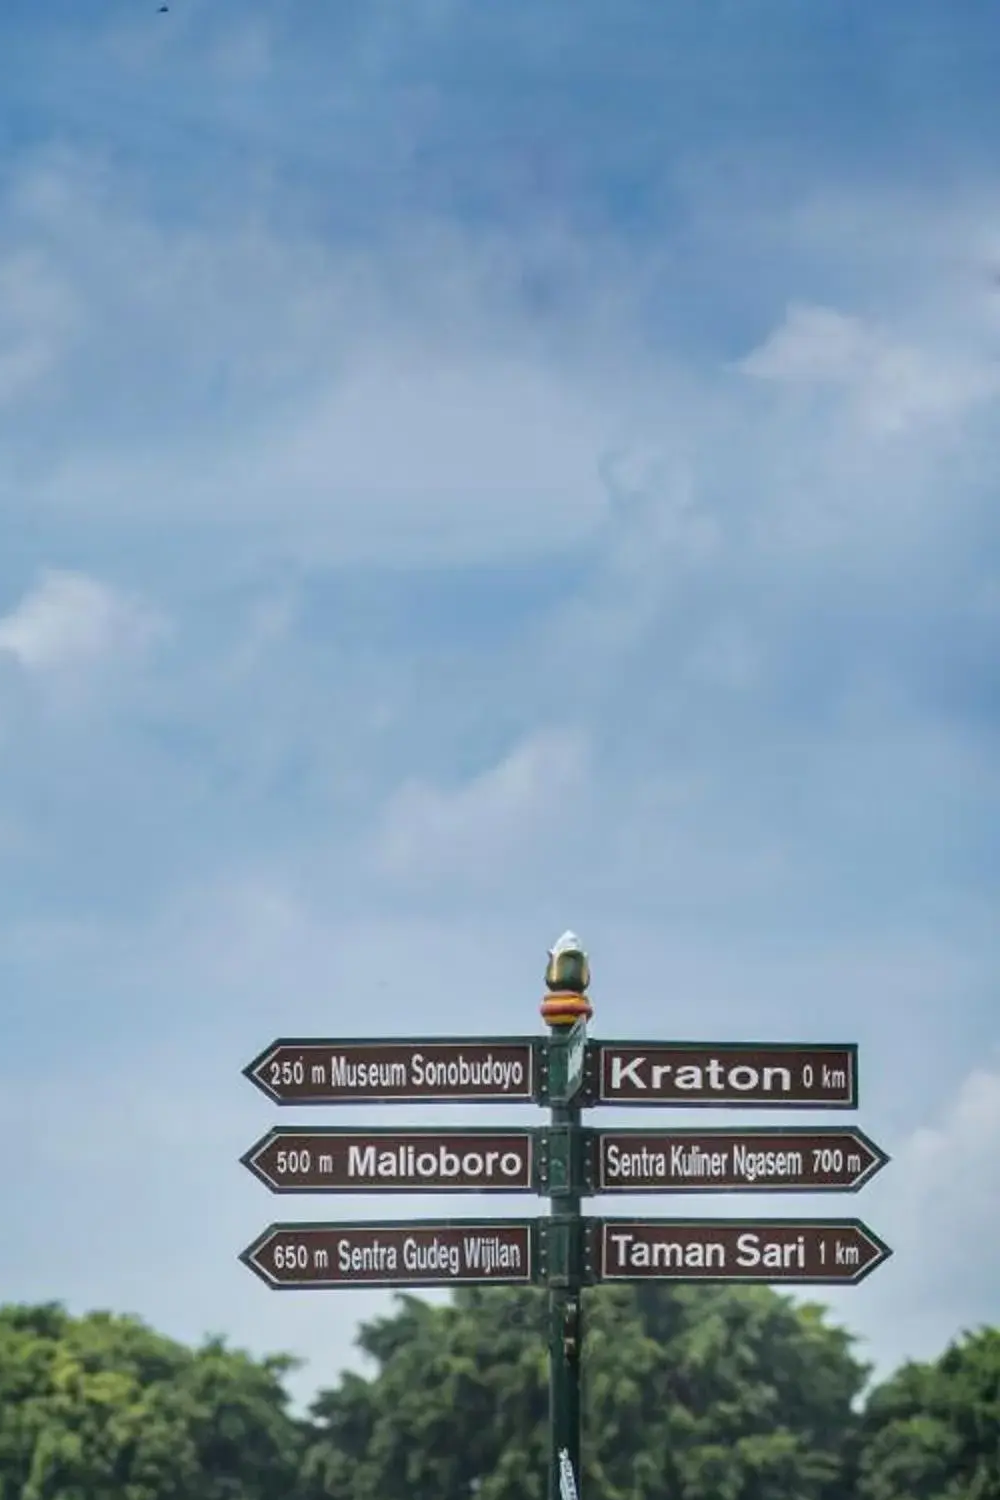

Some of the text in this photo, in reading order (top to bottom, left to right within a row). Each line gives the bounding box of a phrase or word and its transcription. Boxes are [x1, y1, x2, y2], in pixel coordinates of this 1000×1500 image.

[270, 1054, 524, 1089] 250 m Museum Sonobudoyo
[611, 1057, 846, 1091] Kraton 0 km
[277, 1146, 522, 1176] 500 m Malioboro
[607, 1144, 861, 1181] Sentra Kuliner Ngasem 700 m
[274, 1237, 521, 1274] 650 m Sentra Gudeg Wijilan
[611, 1234, 860, 1268] Taman Sari 1 km
